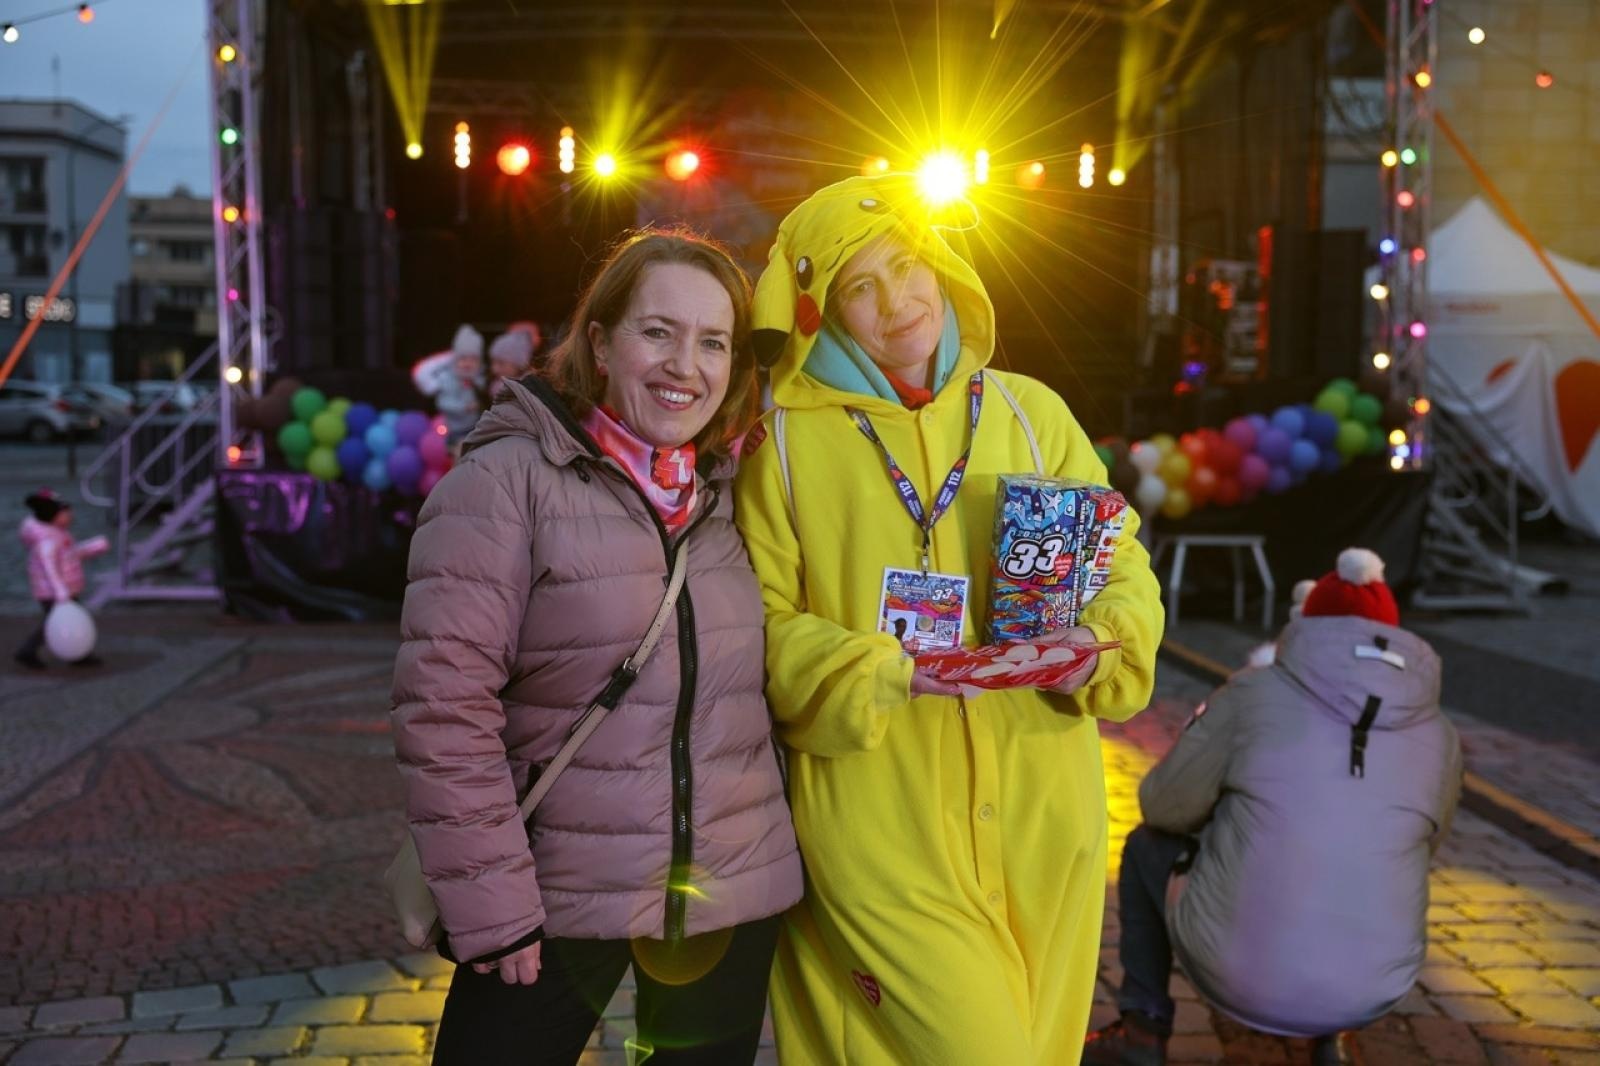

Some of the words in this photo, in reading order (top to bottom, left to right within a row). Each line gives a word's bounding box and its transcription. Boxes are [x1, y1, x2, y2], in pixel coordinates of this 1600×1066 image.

[948, 471, 962, 486] 112
[900, 480, 913, 497] 112
[1006, 537, 1064, 576] 33
[932, 588, 953, 600] 33
